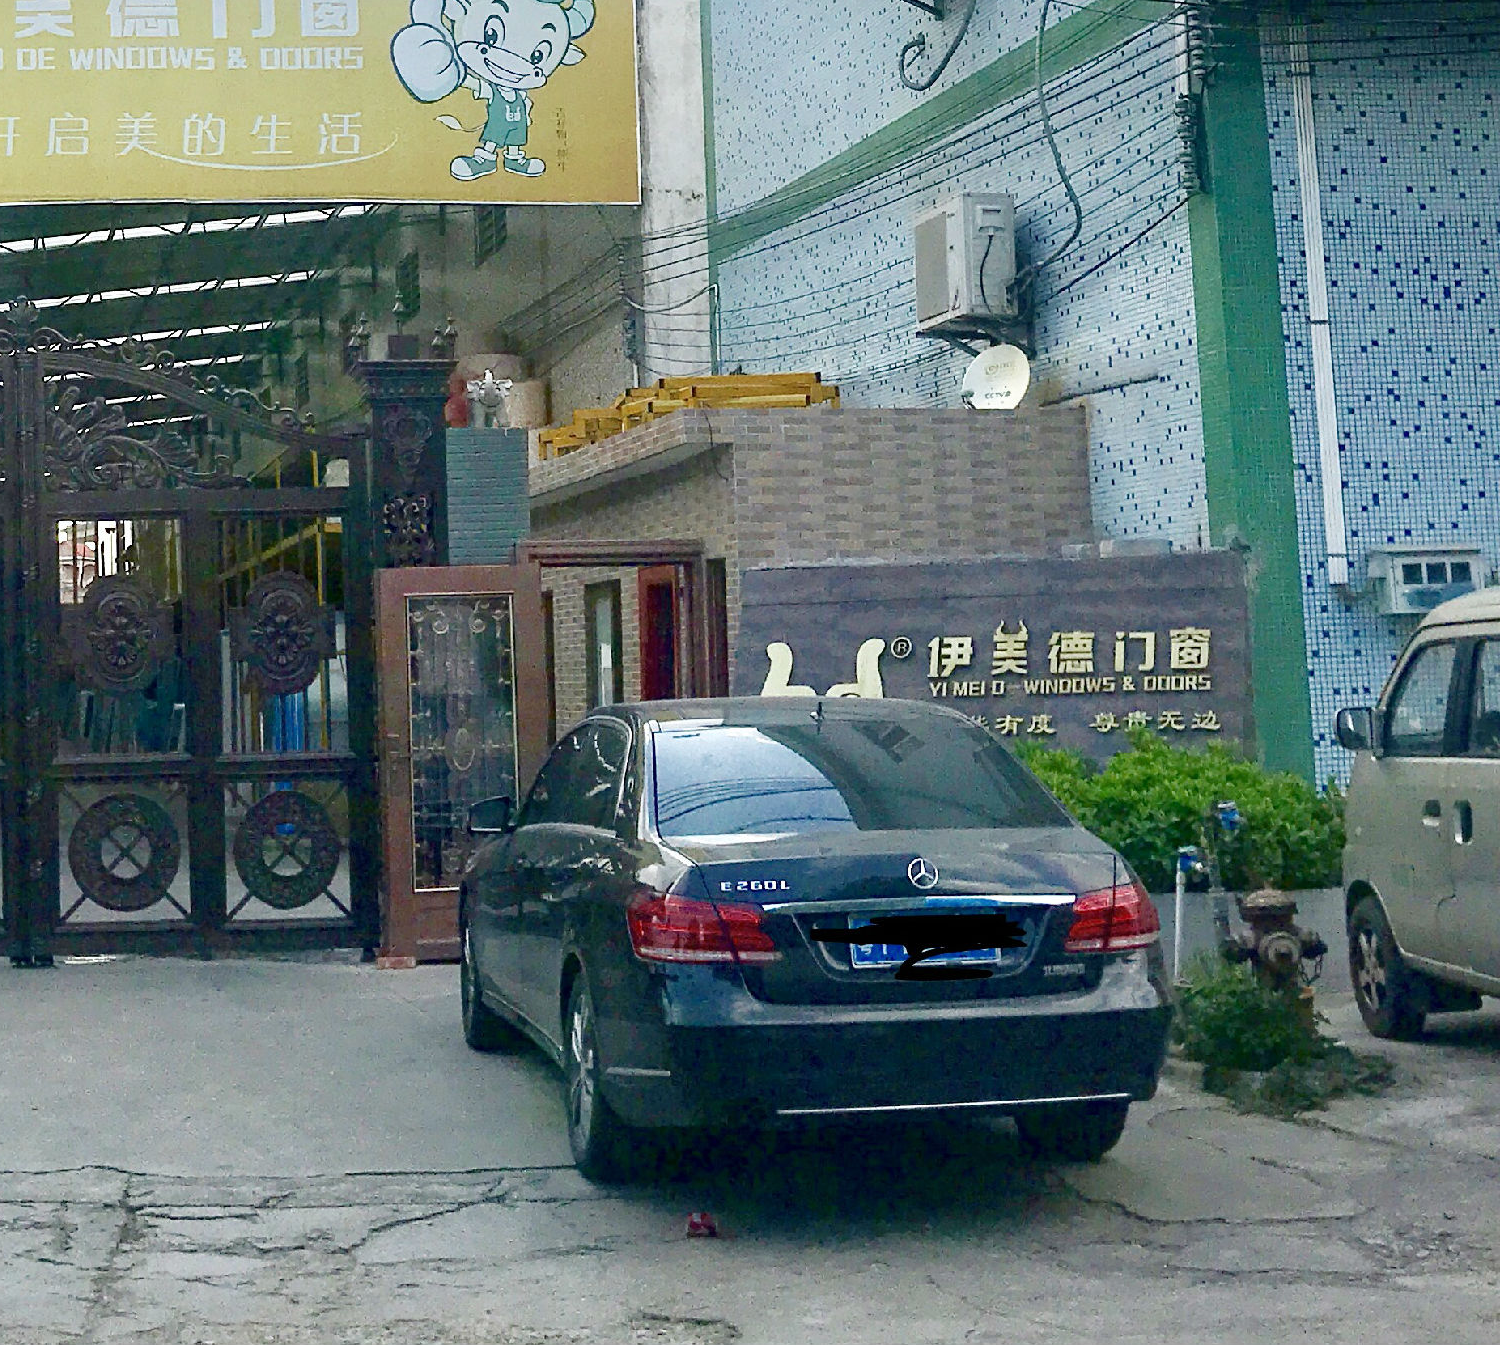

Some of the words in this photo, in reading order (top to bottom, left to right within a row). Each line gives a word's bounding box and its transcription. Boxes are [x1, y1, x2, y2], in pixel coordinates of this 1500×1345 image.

[16, 46, 56, 71] DE
[69, 46, 215, 71] WINDOWS
[227, 46, 248, 70] &
[259, 46, 364, 70] DOORS
[927, 619, 1212, 678] 伊美德门窗
[929, 681, 947, 697] YI
[953, 680, 985, 696] MEI
[1023, 677, 1116, 695] WINDOWS
[1122, 676, 1136, 692] &
[1143, 675, 1213, 692] DOORS
